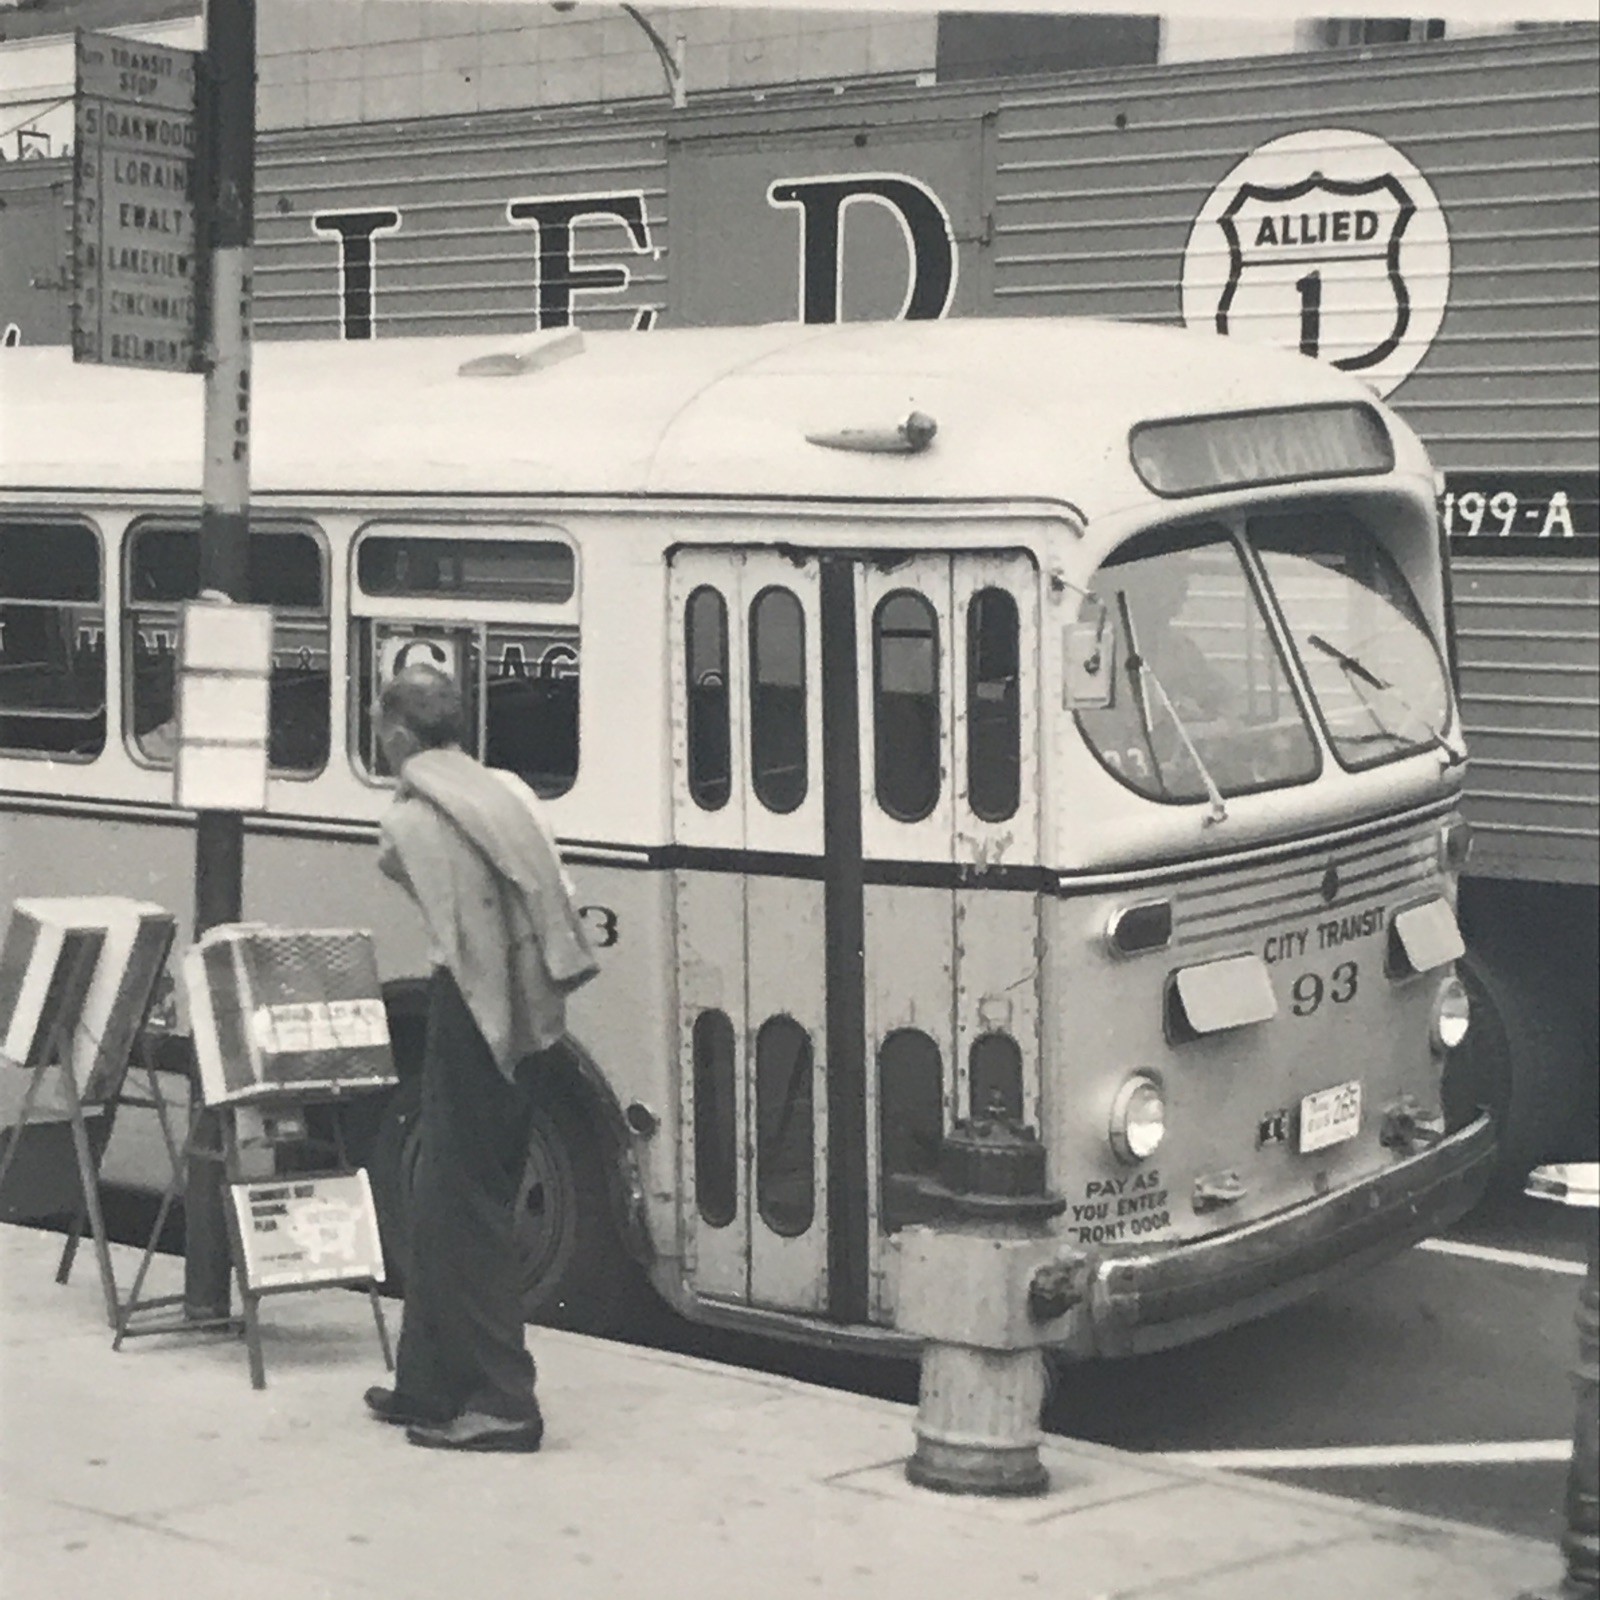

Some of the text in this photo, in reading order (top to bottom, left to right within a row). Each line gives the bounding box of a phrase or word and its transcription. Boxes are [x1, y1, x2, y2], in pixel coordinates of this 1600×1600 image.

[114, 157, 187, 191] LORAIN
[1255, 209, 1379, 246] ALLIED
[1296, 269, 1322, 358] 1
[1263, 906, 1386, 965] CITY TRANSIT
[1291, 960, 1360, 1017] 93
[1085, 1169, 1160, 1199] PAY AS
[1072, 1202, 1110, 1222] YOU
[1131, 1210, 1172, 1235] DOOR
